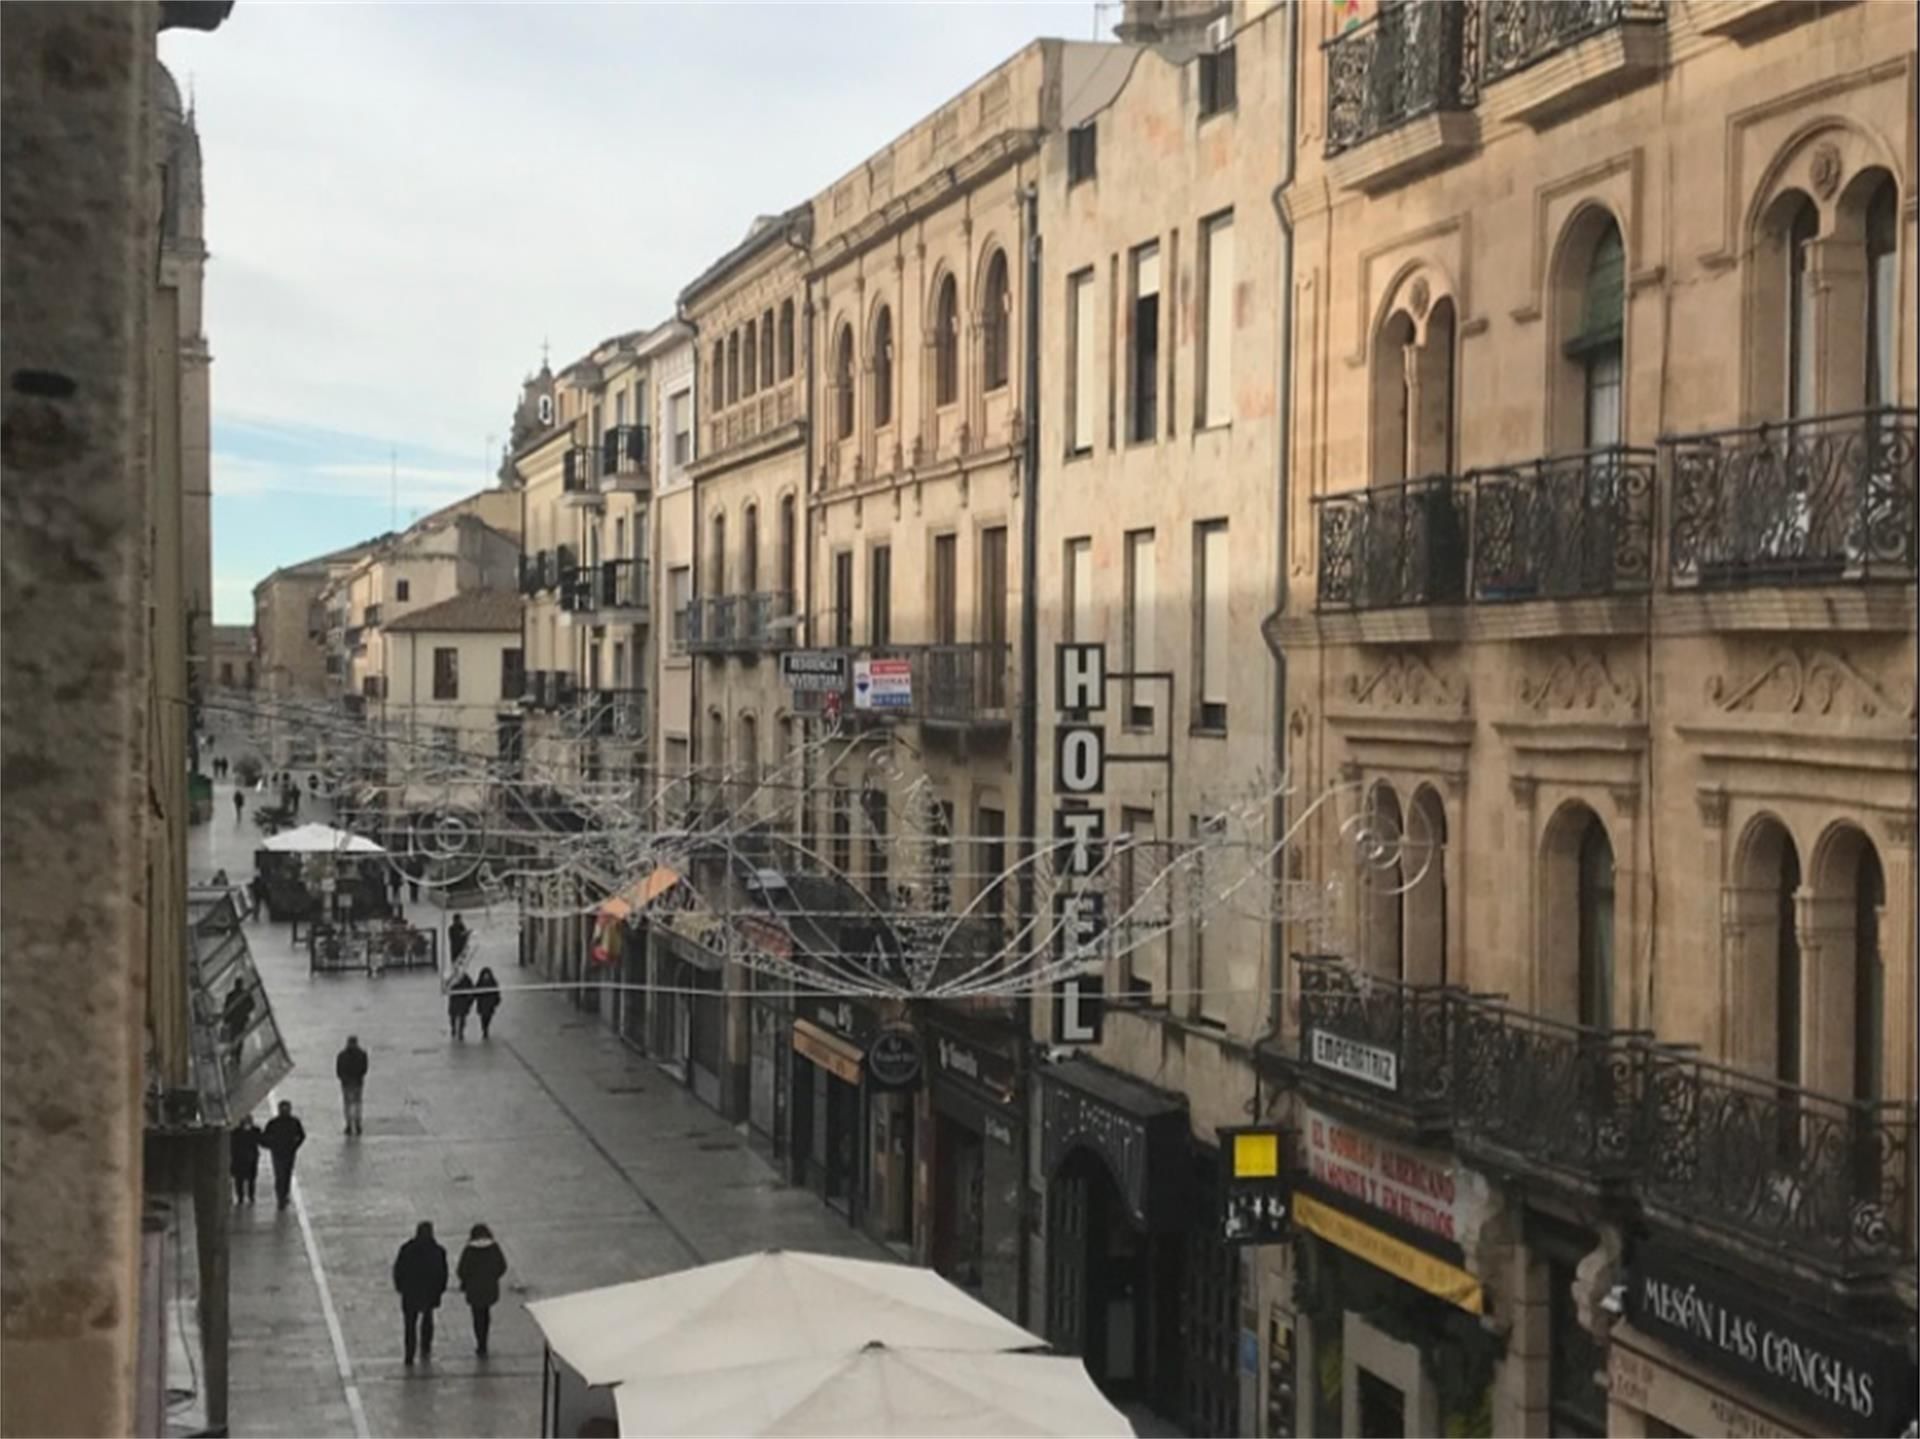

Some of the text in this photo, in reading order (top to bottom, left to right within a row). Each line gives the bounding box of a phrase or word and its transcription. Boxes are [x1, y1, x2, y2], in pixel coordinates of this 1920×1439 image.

[1062, 647, 1101, 1041] HOTEL
[1317, 1035, 1391, 1083] EMPERATRIZ
[1642, 1277, 1873, 1417] MESÓN LAS CONCHAS
